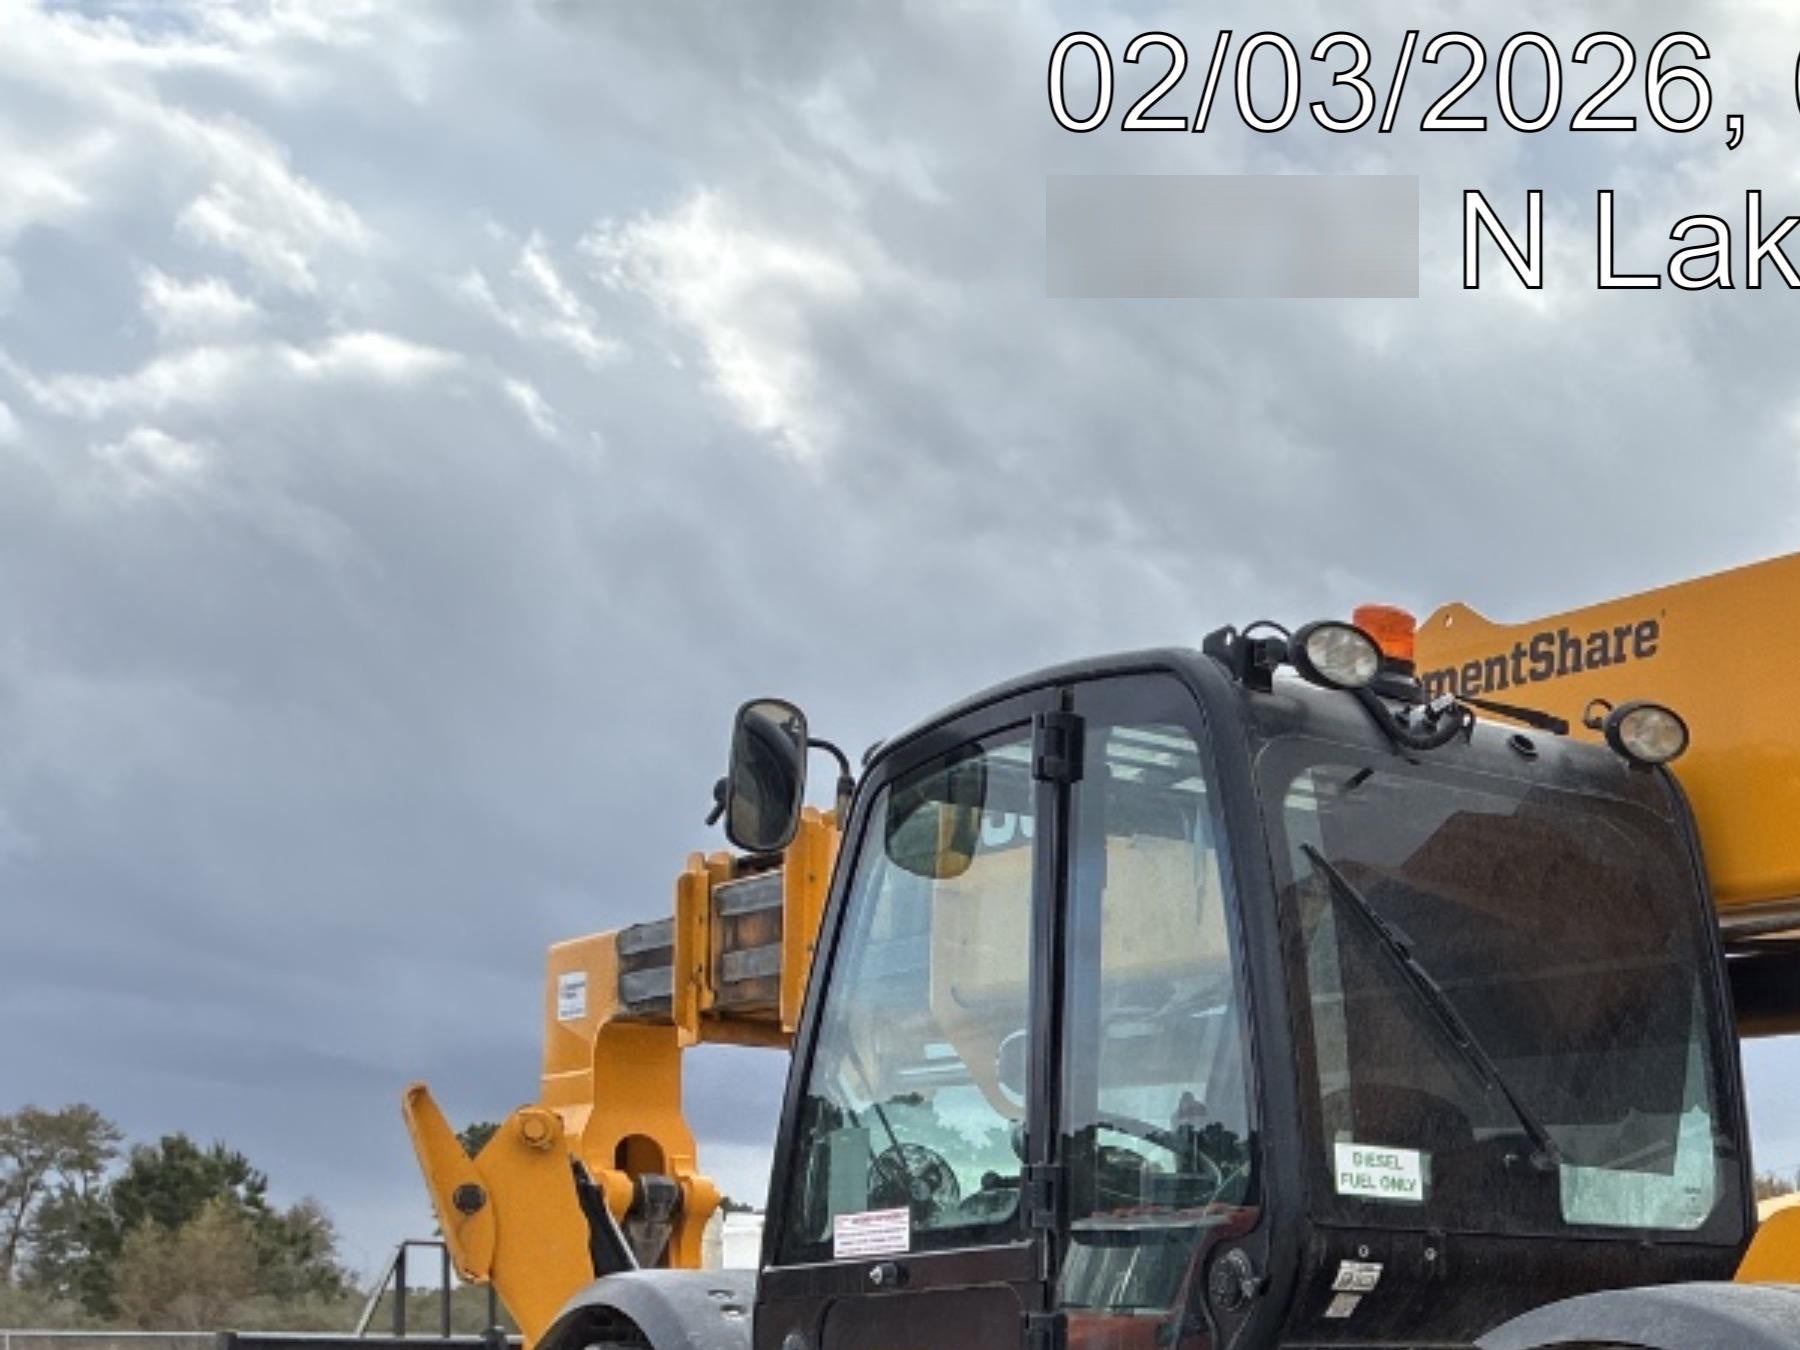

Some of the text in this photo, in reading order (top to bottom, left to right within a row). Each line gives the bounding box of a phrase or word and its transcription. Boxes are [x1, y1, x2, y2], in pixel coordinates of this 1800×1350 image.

[1352, 1151, 1404, 1170] DIESEL
[1340, 1172, 1417, 1192] FUEL ONLY
